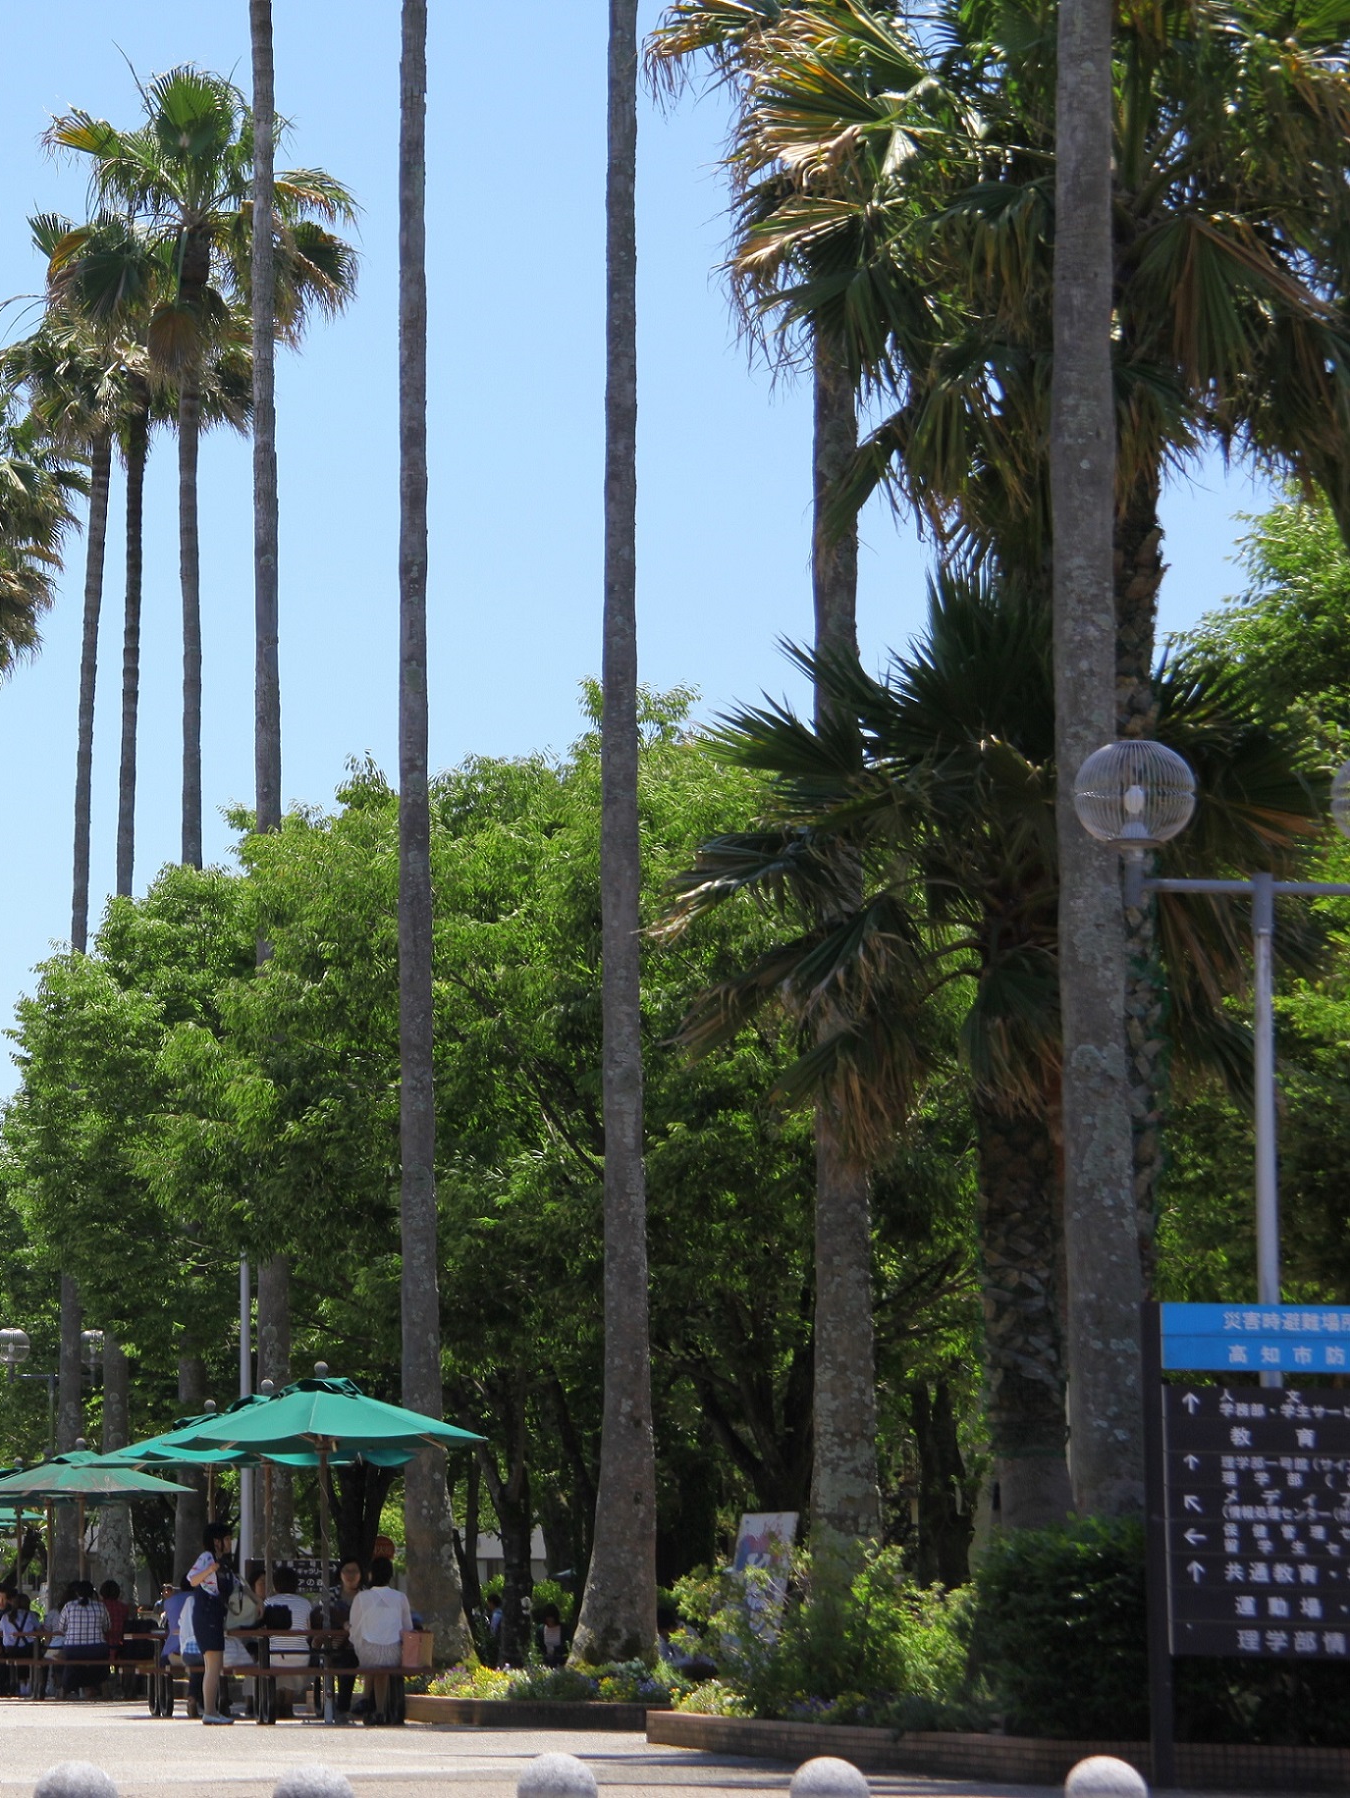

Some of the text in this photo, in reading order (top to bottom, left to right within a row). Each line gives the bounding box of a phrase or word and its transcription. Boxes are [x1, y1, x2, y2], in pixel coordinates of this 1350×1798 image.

[1221, 1471, 1350, 1489] 理学部(
[1224, 1561, 1350, 1584] 共通教育・
